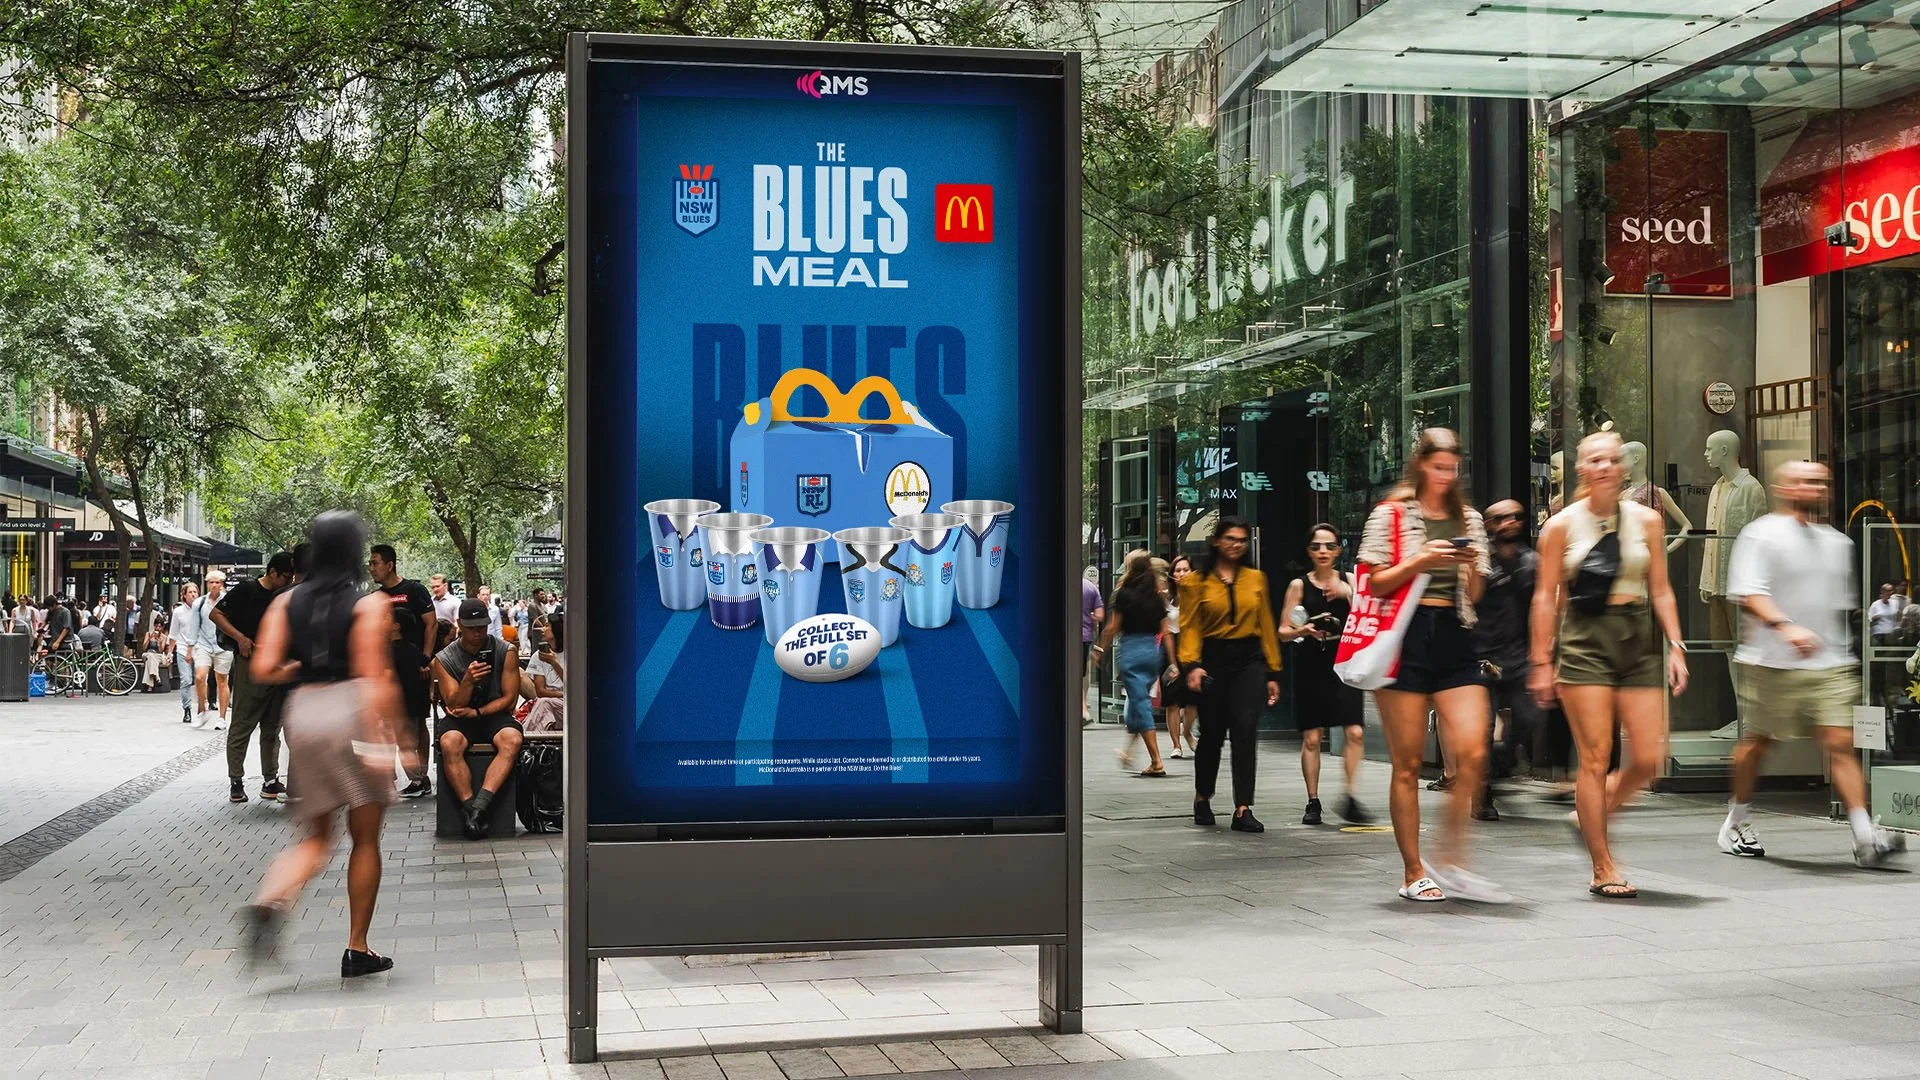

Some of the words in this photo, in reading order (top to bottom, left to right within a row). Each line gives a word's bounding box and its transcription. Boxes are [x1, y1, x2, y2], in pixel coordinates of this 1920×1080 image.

[811, 74, 869, 96] QMS
[816, 142, 847, 162] THE
[679, 201, 713, 214] NSW
[753, 164, 908, 254] BLUES
[682, 215, 711, 224] BLUES
[1621, 206, 1714, 245] seed
[753, 256, 909, 289] MEAL
[801, 486, 826, 494] NSW
[894, 490, 929, 498] McDonald's
[1210, 488, 1237, 499] MAX
[1687, 487, 1708, 496] FIRE
[806, 494, 824, 509] RL
[89, 531, 104, 542] JD
[798, 622, 855, 638] COLLECT
[1343, 613, 1379, 637] BAG
[785, 638, 808, 652] THE
[810, 632, 844, 646] FULL
[846, 630, 868, 641] SET
[804, 650, 827, 667] OF
[829, 642, 849, 670] 6
[744, 758, 774, 766] participating
